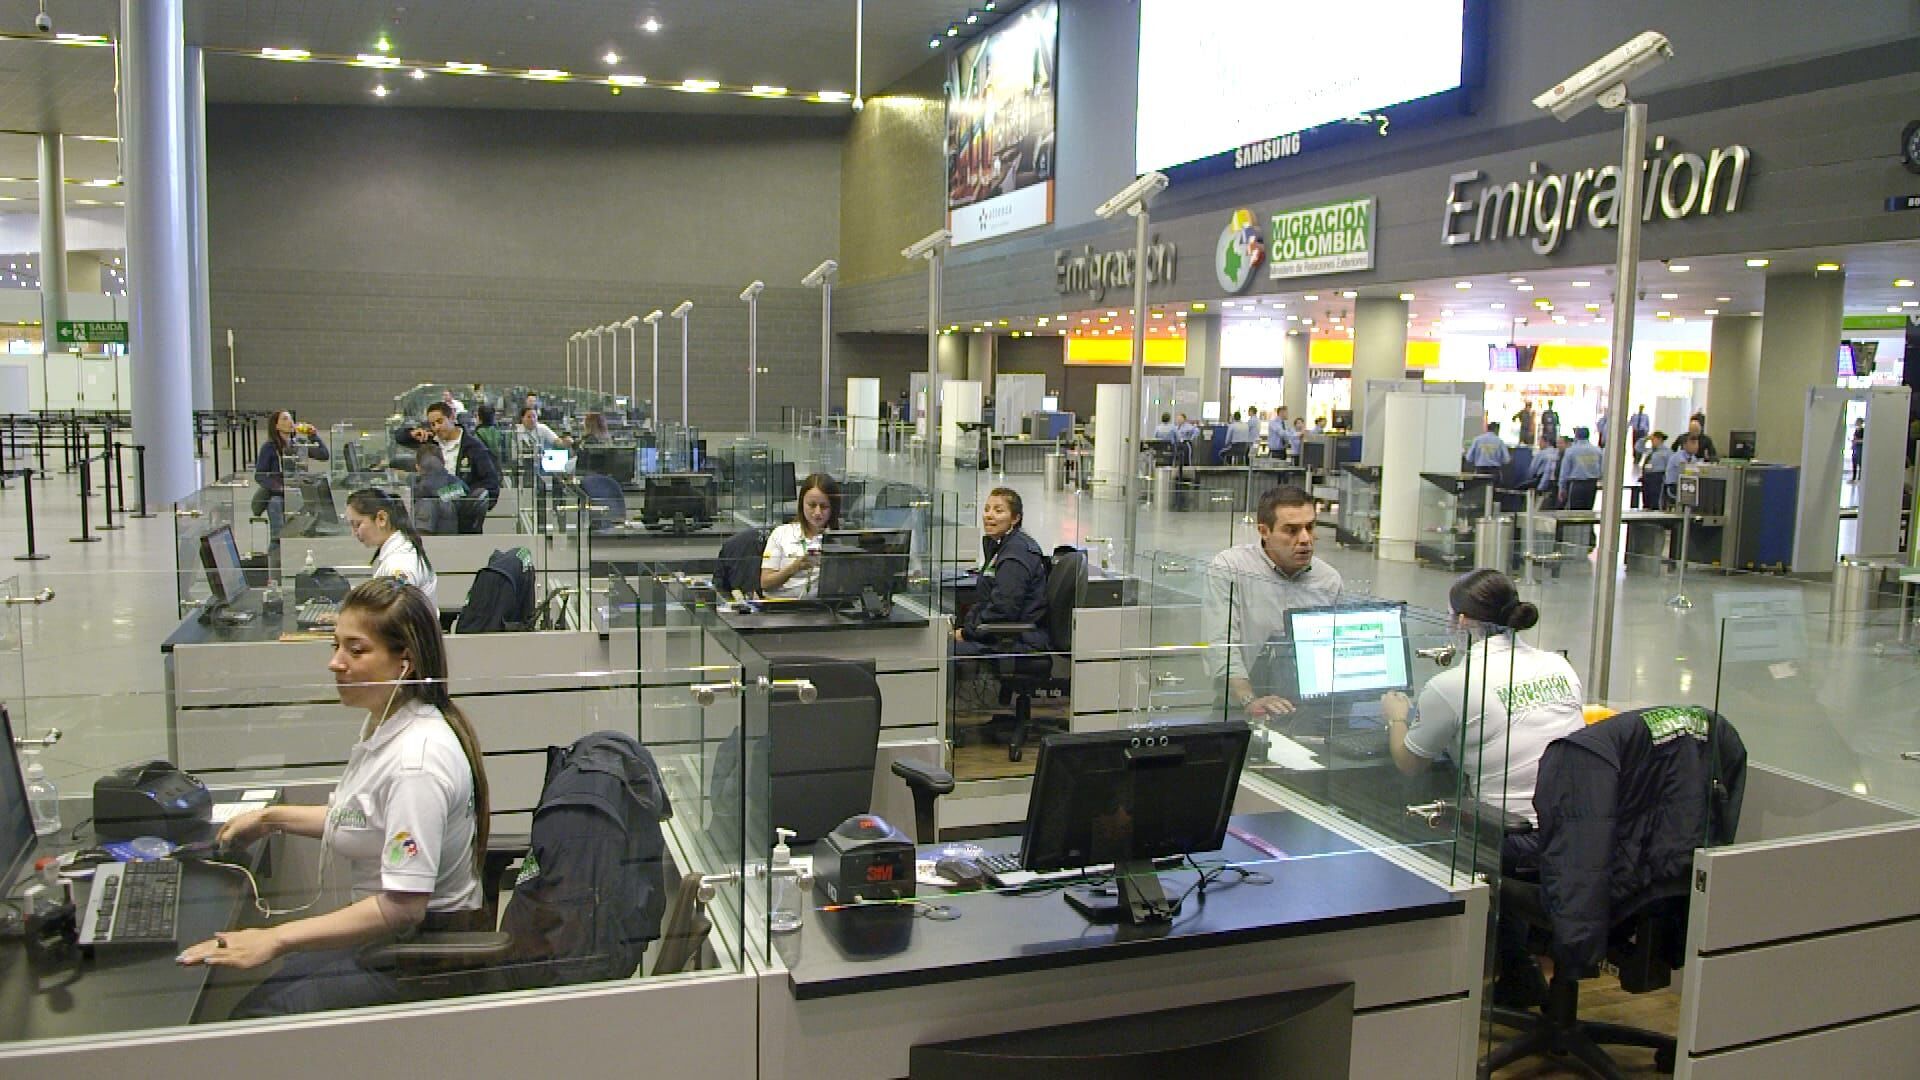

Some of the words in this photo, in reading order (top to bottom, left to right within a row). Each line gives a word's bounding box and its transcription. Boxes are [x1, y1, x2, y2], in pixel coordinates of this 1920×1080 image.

[1234, 133, 1300, 169] SAMSUNG
[1441, 135, 1751, 255] Emigraion
[1272, 228, 1367, 260] COLOMBIA
[88, 323, 125, 331] SALIDA
[1311, 369, 1336, 379] Dior
[866, 864, 894, 881] 3M
